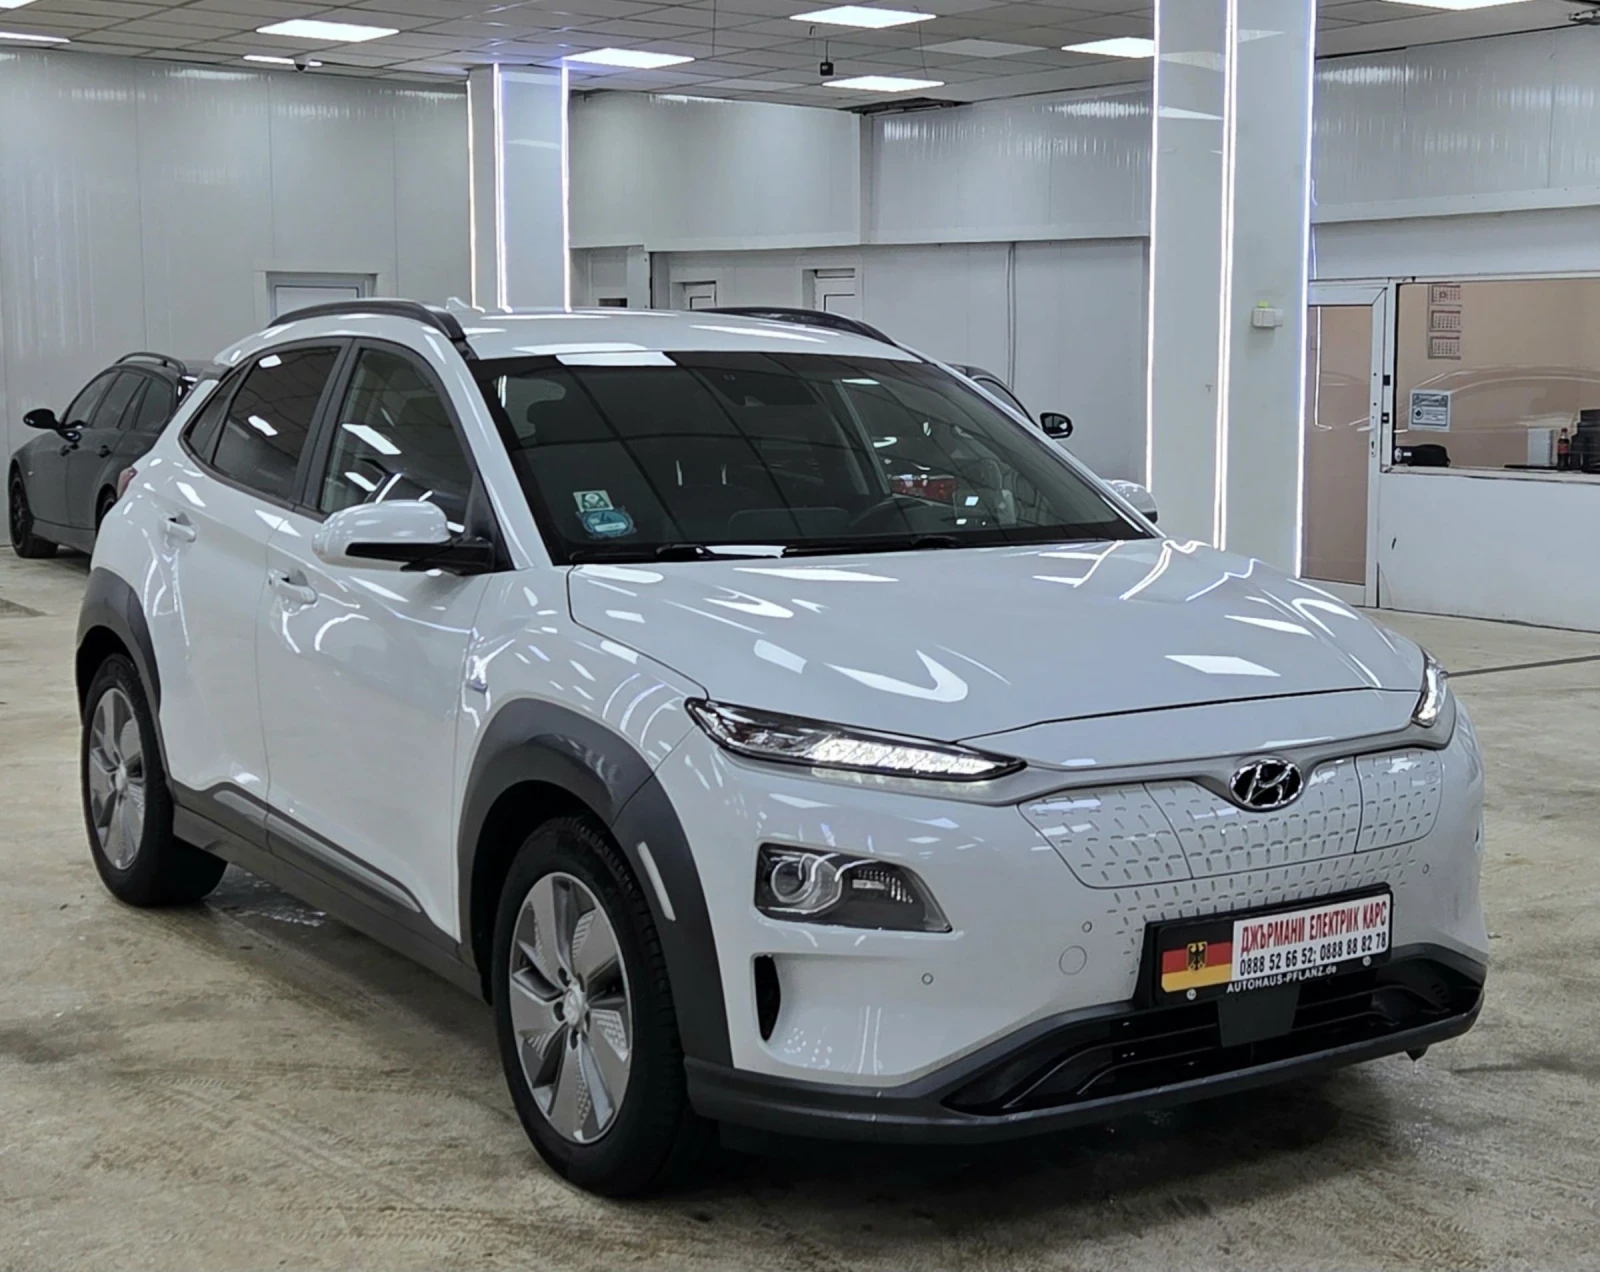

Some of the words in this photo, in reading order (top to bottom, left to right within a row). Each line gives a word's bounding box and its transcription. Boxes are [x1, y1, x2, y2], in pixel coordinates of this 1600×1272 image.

[1239, 955, 1265, 977] 0888
[1269, 952, 1281, 972] 52
[1285, 949, 1297, 969] 66
[1320, 940, 1343, 962] 0888
[1346, 937, 1358, 956] 88
[1361, 934, 1372, 953] 82
[1376, 931, 1387, 949] 78
[1240, 916, 1305, 958] ДЖЪРМАНИ
[1309, 906, 1360, 941] ЕЛЕКТРИК
[1362, 900, 1387, 931] КАРС
